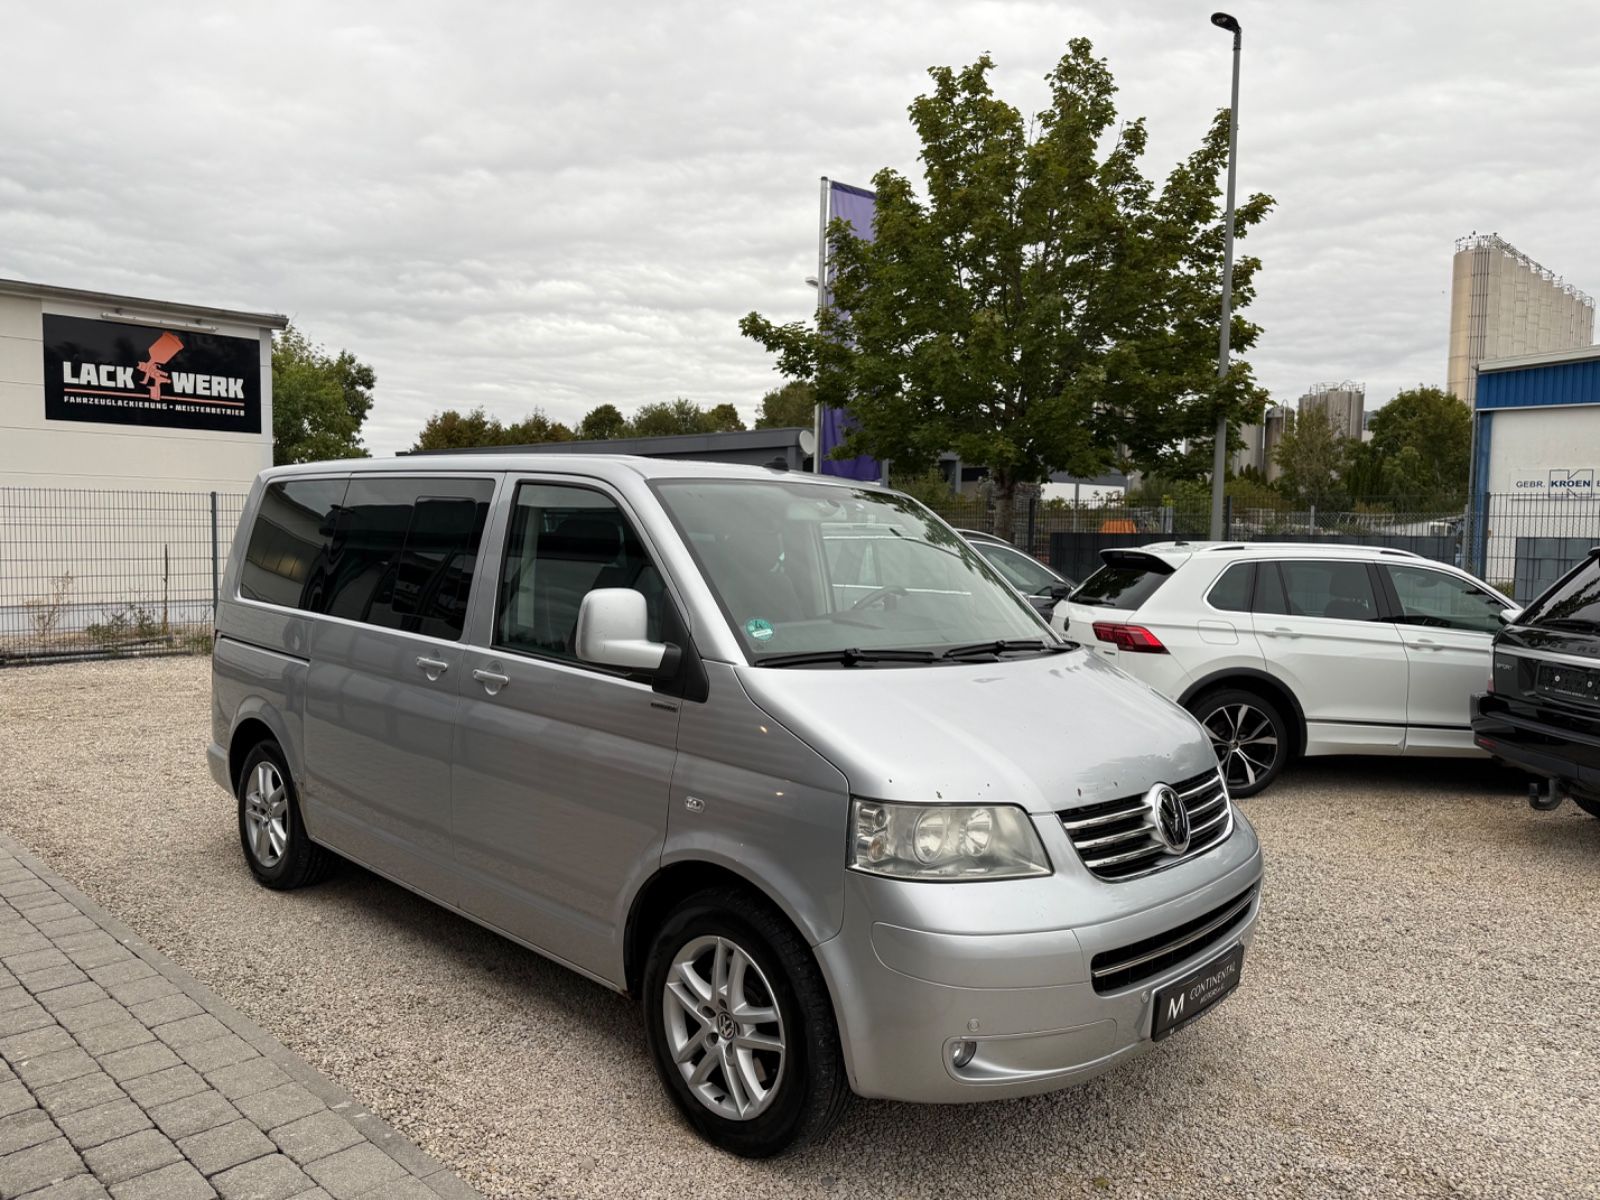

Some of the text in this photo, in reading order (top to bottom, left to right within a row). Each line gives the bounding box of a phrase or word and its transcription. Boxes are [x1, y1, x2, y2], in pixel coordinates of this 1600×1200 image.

[63, 361, 245, 399] LACK WERK
[63, 395, 245, 416] FAHRZEUGLACKIERUNG MEISTERBETRIEB
[1550, 480, 1591, 488] KROEN
[1167, 992, 1185, 1021] M
